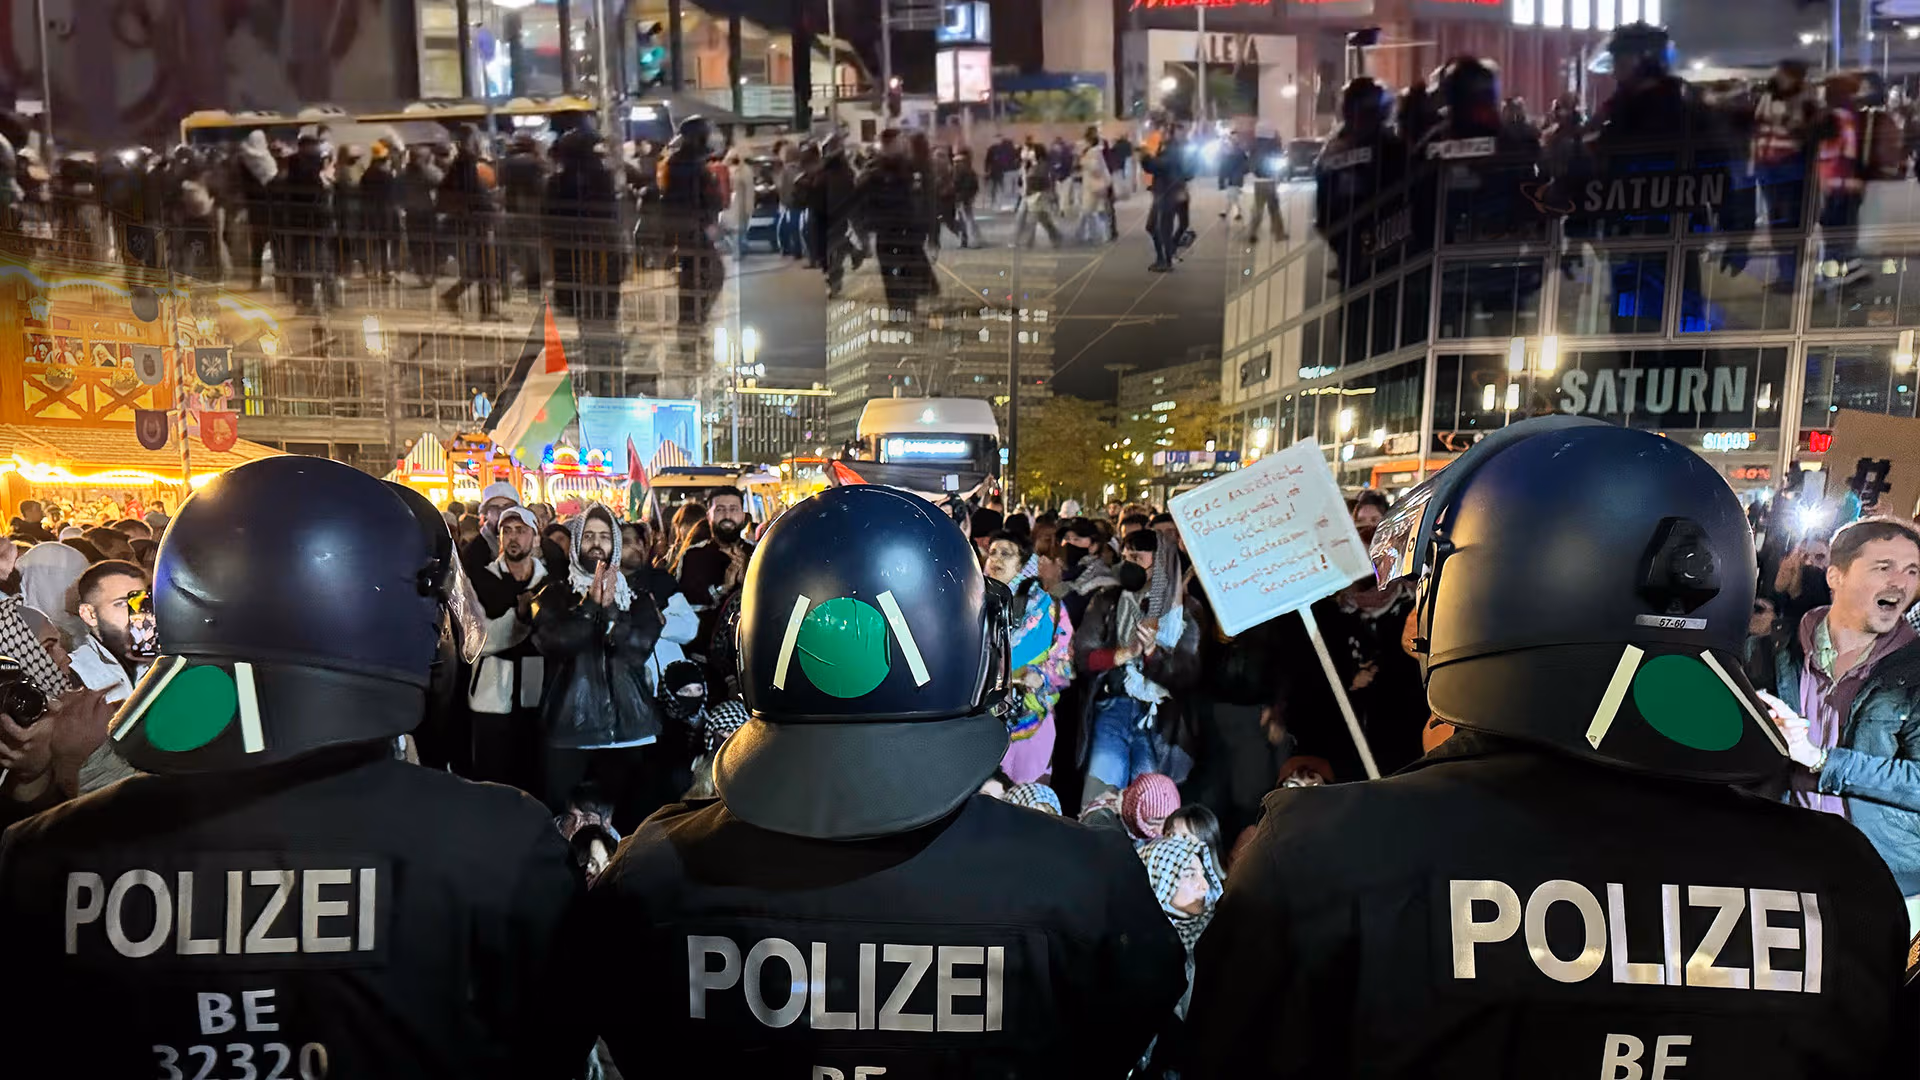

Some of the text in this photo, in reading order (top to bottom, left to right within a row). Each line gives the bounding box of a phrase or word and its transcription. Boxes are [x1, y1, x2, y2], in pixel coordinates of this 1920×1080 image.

[1584, 172, 1725, 212] SATURN
[1560, 367, 1747, 414] SATURN
[1659, 618, 1686, 628] 57-60
[65, 868, 376, 957] POLIZEI
[1450, 879, 1822, 993] POLIZEI
[688, 936, 1004, 1032] POLIZEI
[197, 989, 279, 1035] BE
[153, 1042, 328, 1080] 32320
[1600, 1033, 1692, 1080] BE
